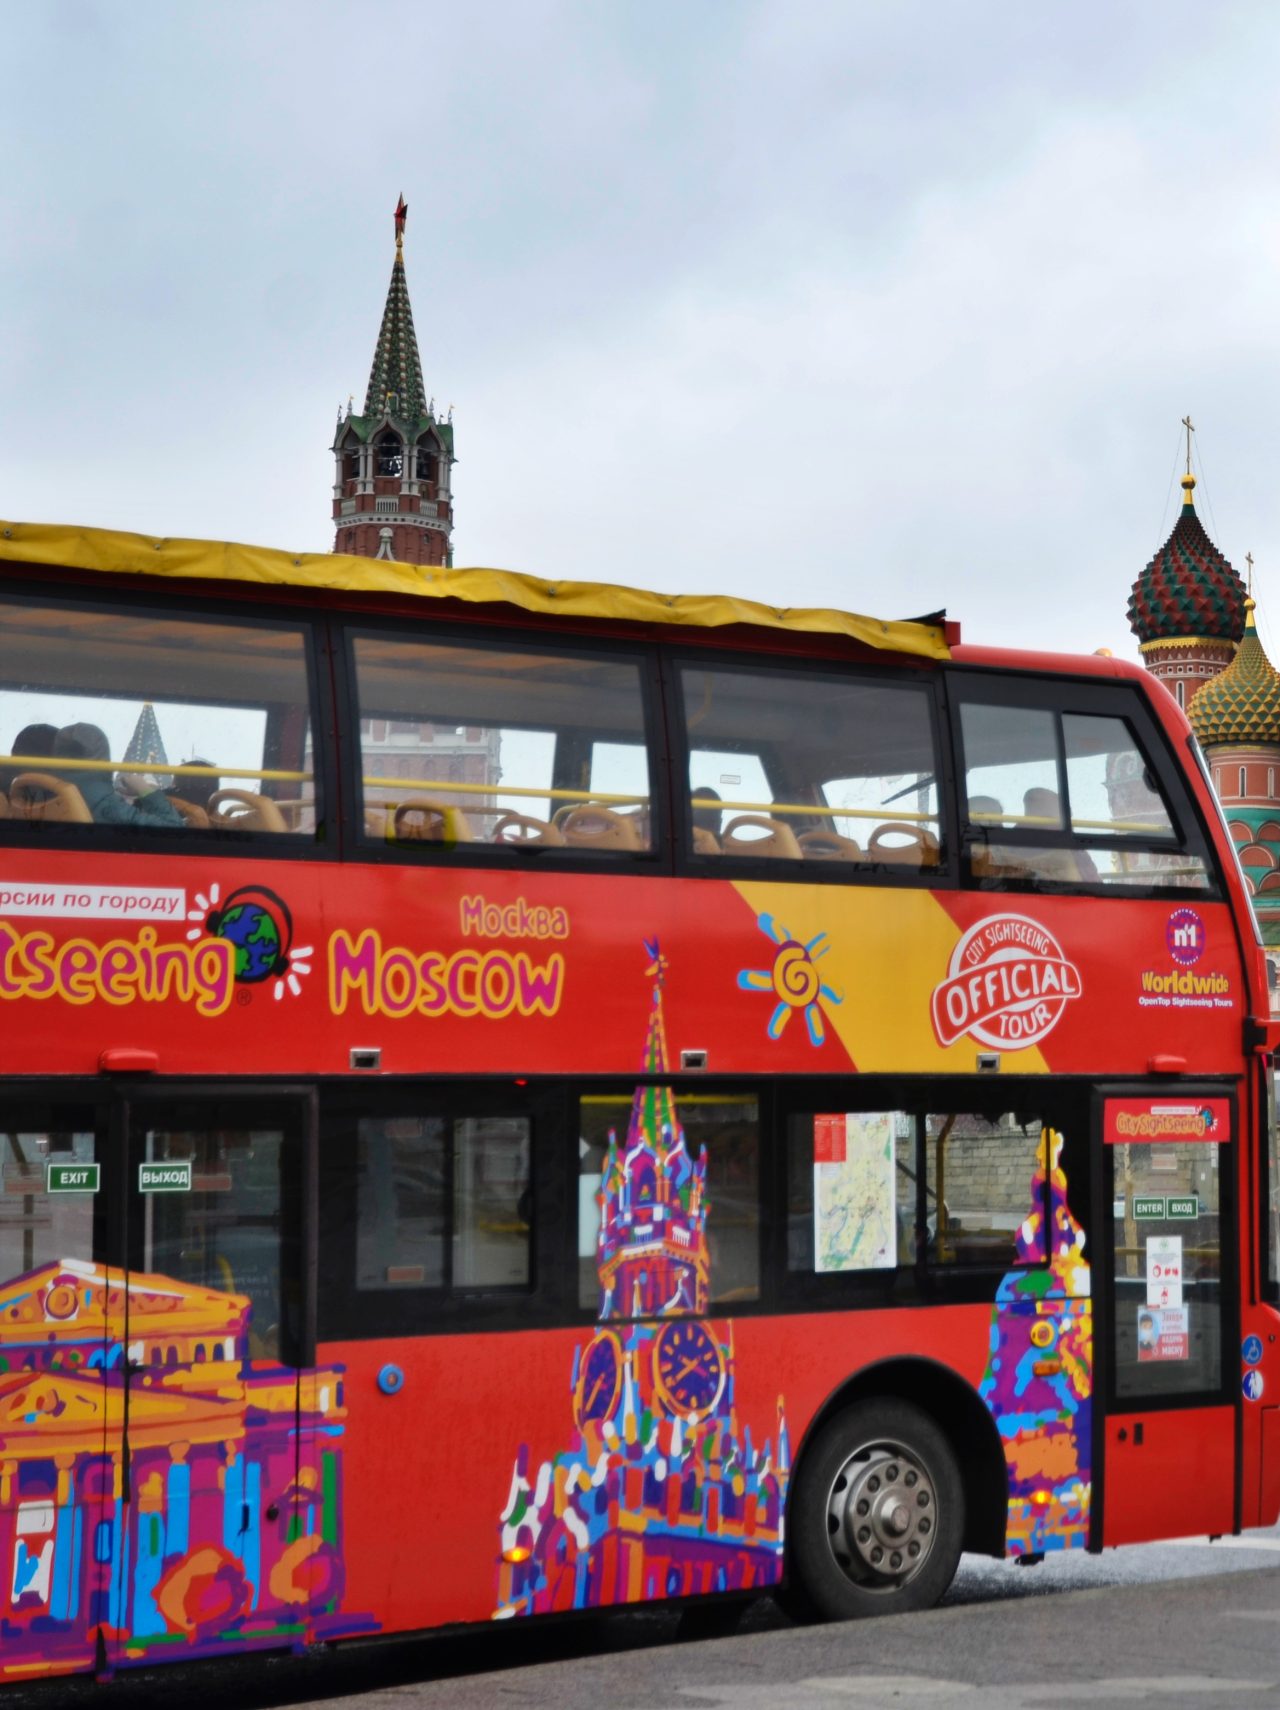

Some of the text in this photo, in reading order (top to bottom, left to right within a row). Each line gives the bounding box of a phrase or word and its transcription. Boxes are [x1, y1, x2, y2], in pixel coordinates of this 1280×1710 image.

[62, 893, 91, 909] по
[99, 893, 179, 914] городу
[460, 895, 569, 939] Москва
[966, 922, 1050, 965] CITY SIGHTSEEING
[1142, 970, 1229, 994] Worldwide
[946, 963, 1076, 1026] OFFICIAL
[1172, 997, 1212, 1007] Sightseeing
[1213, 999, 1232, 1007] Tours
[999, 1003, 1052, 1038] TOUR
[60, 1172, 89, 1184] EXIT
[142, 1171, 188, 1184] ВЫХОД
[1136, 1203, 1163, 1213] ENTER
[1171, 1203, 1193, 1214] ВХОД
